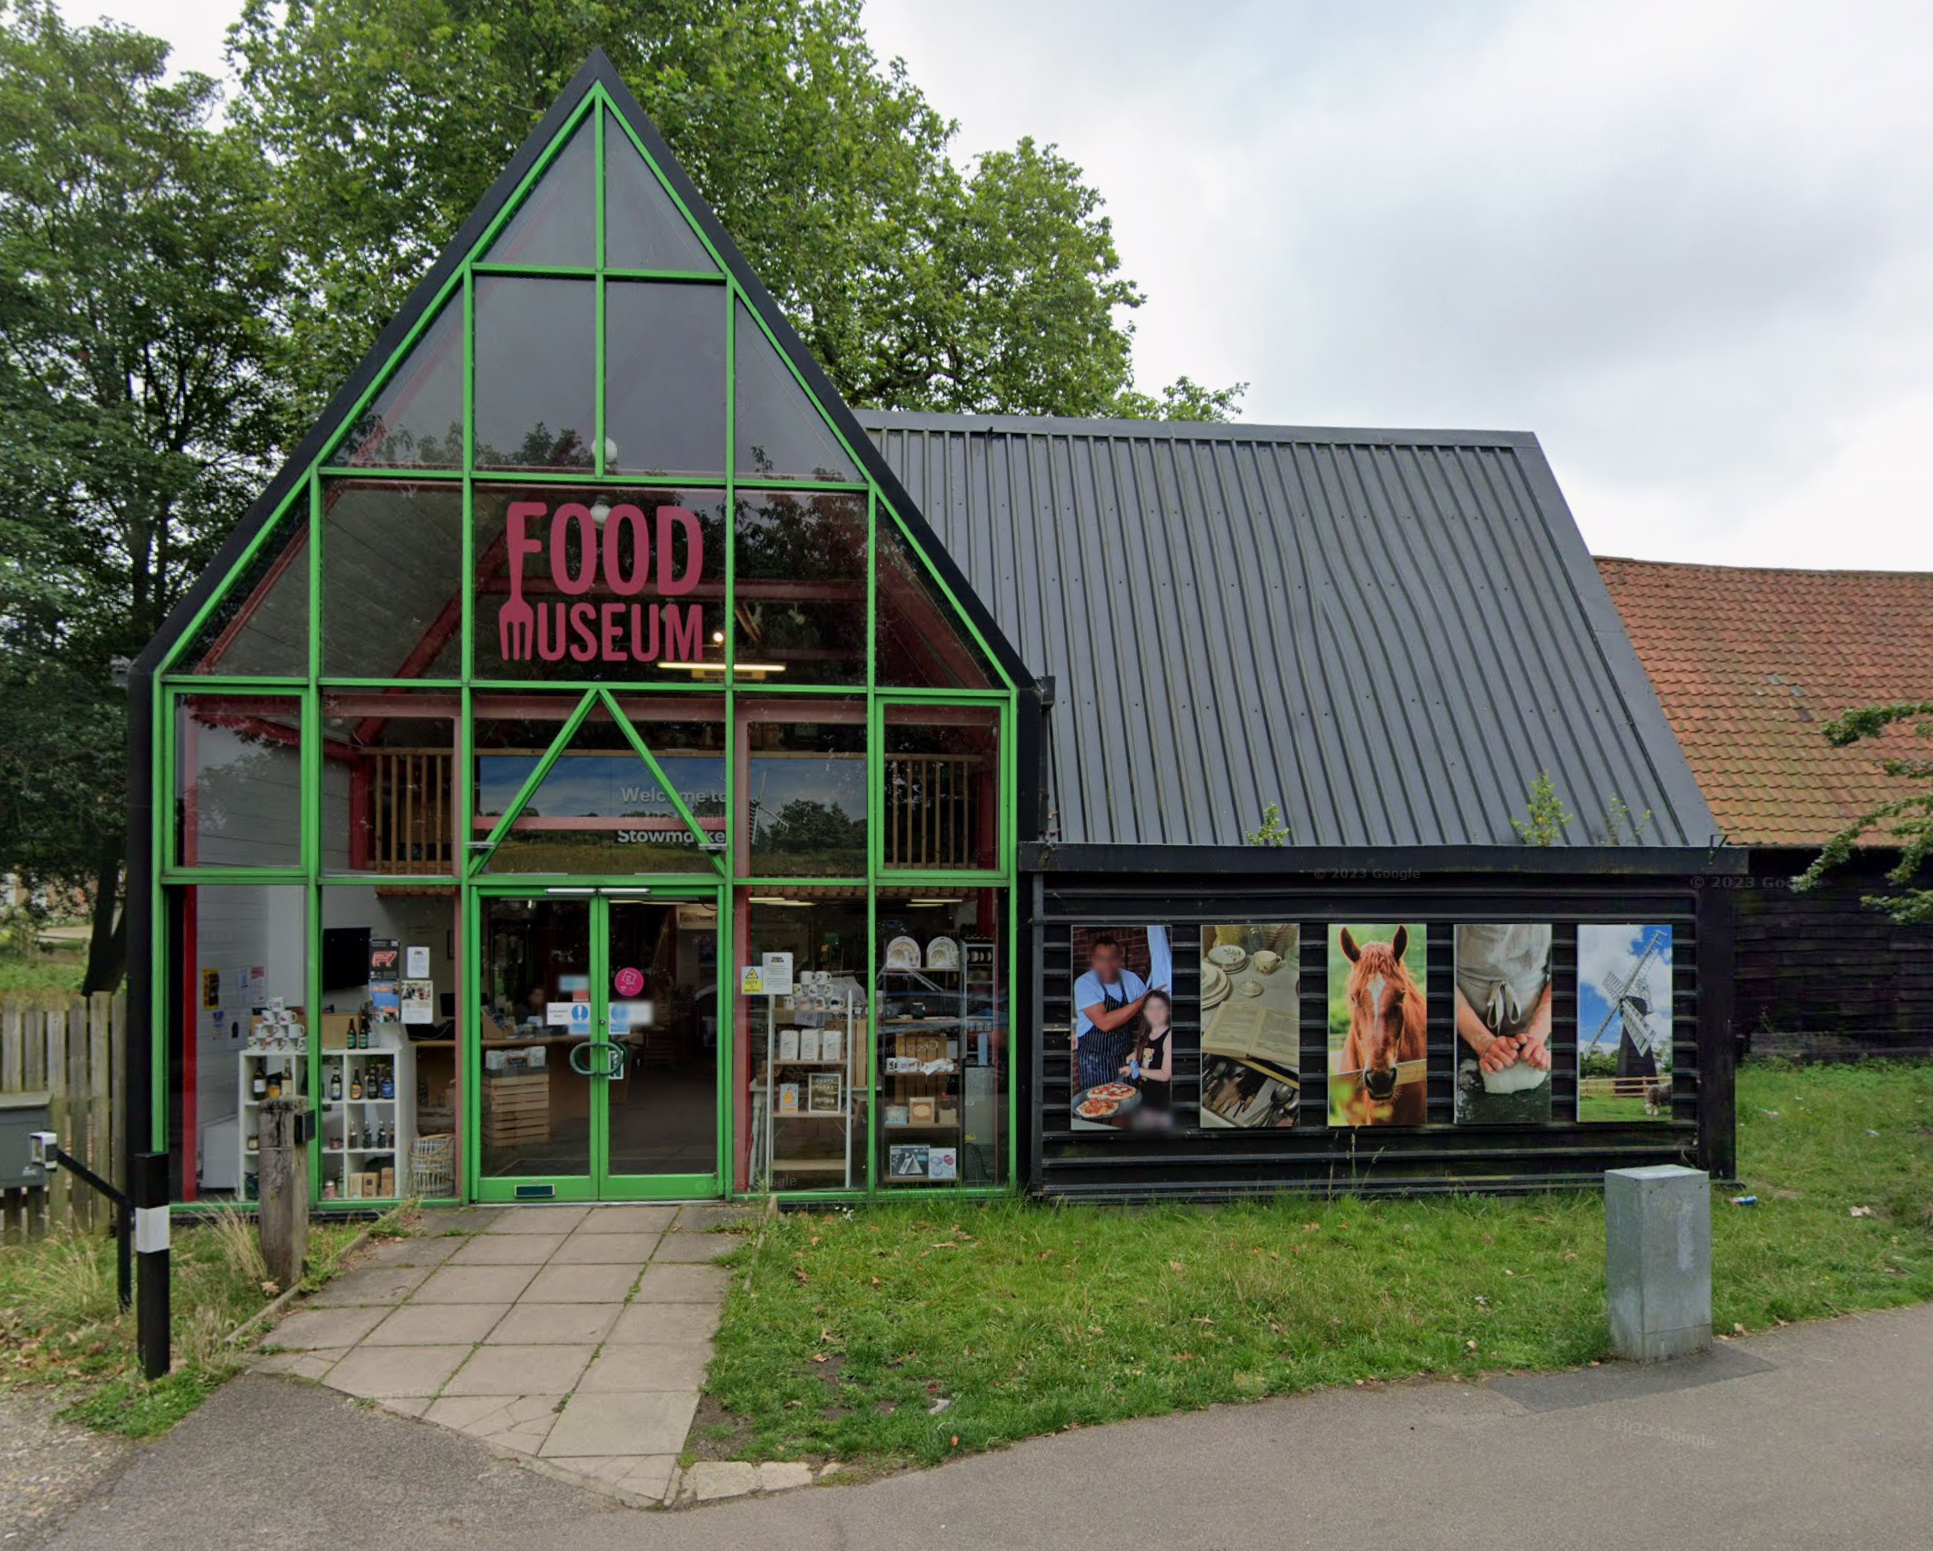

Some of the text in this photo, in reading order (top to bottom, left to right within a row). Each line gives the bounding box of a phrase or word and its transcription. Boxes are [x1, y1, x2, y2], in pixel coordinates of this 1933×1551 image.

[507, 502, 703, 596] FOOD
[499, 600, 703, 662] MUSEUM
[620, 786, 706, 803] Welcme
[617, 829, 727, 844] Stowmake
